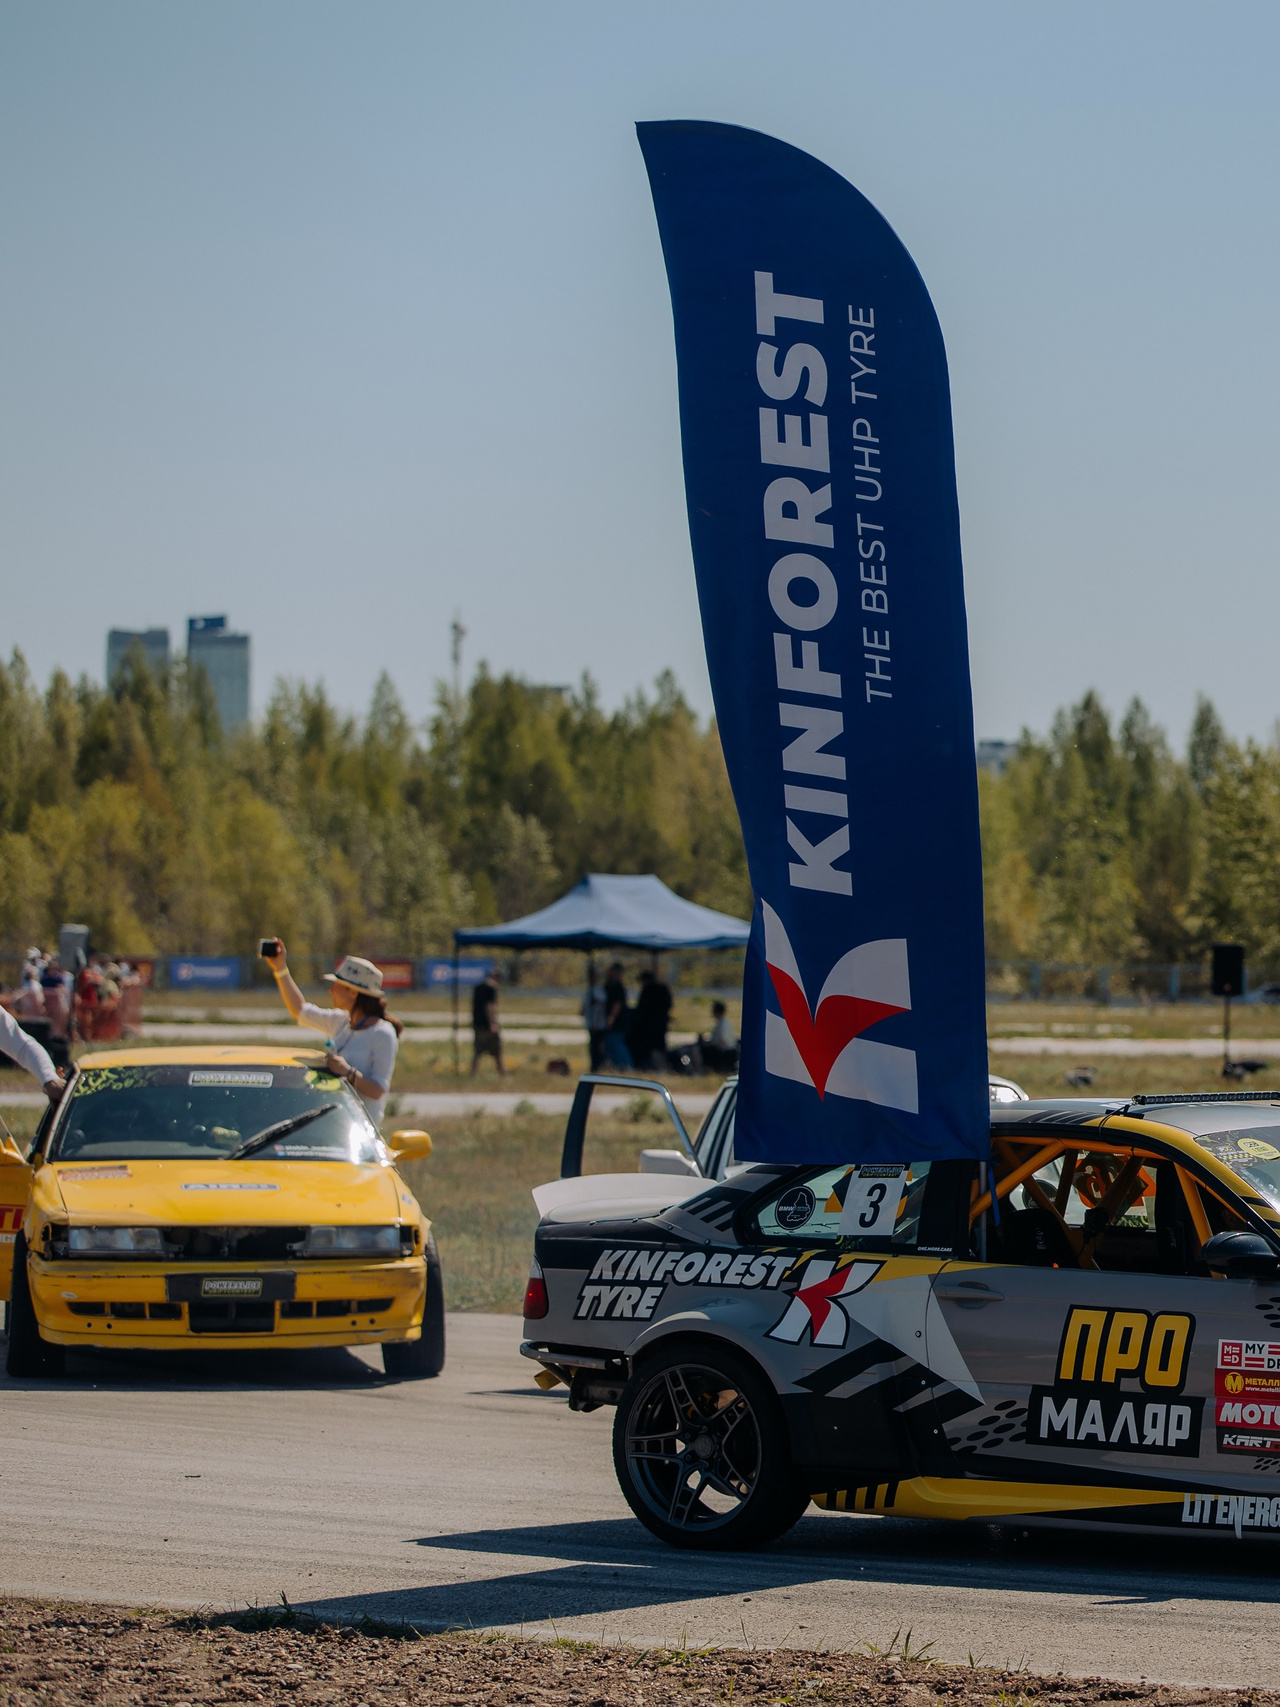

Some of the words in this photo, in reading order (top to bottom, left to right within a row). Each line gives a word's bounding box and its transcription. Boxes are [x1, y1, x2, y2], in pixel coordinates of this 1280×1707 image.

[847, 304, 877, 403] TYRE
[852, 418, 883, 502] UHP
[754, 270, 854, 897] KINFOREST
[857, 513, 889, 614] BEST
[863, 626, 893, 704] THE
[858, 1182, 888, 1229] 3
[576, 1285, 664, 1318] TYRE
[589, 1249, 796, 1288] KINFOREST
[1060, 1308, 1191, 1388] ПРО
[1245, 1343, 1265, 1355] MY
[1039, 1396, 1192, 1447] МАЛЯР
